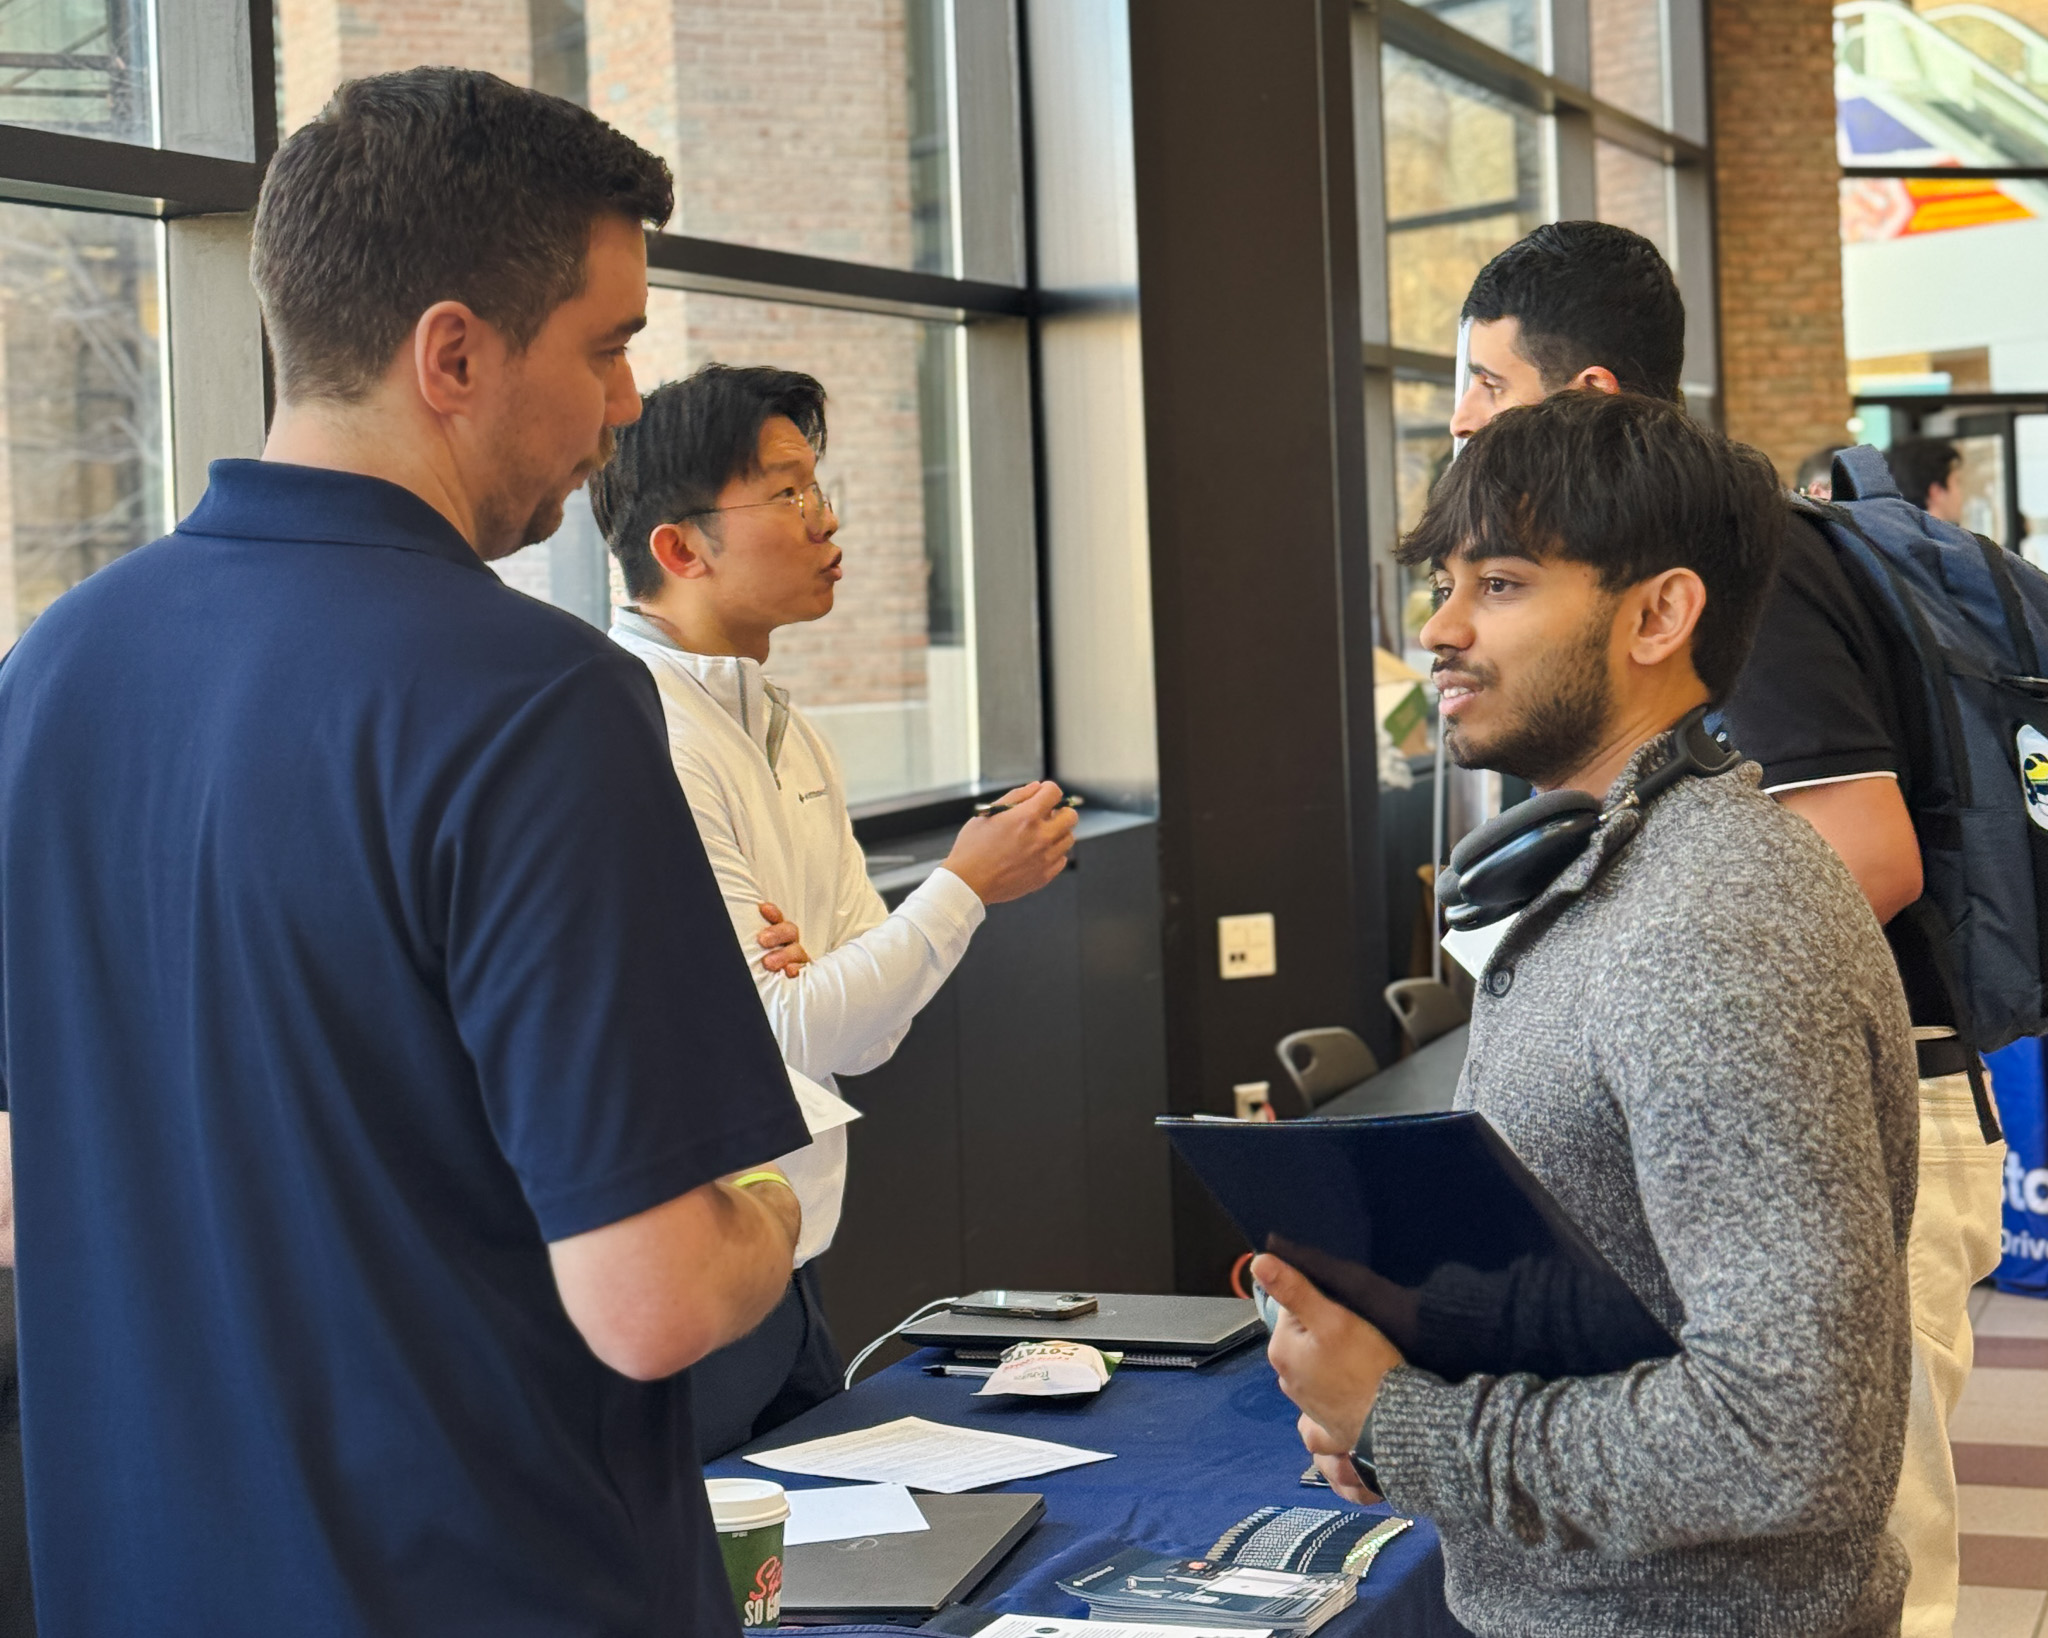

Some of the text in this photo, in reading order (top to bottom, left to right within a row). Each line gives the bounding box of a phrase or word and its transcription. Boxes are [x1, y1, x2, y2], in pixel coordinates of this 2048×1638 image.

[2001, 1151, 2048, 1215] to
[2001, 1227, 2048, 1261] Driv
[744, 1598, 764, 1627] SO
